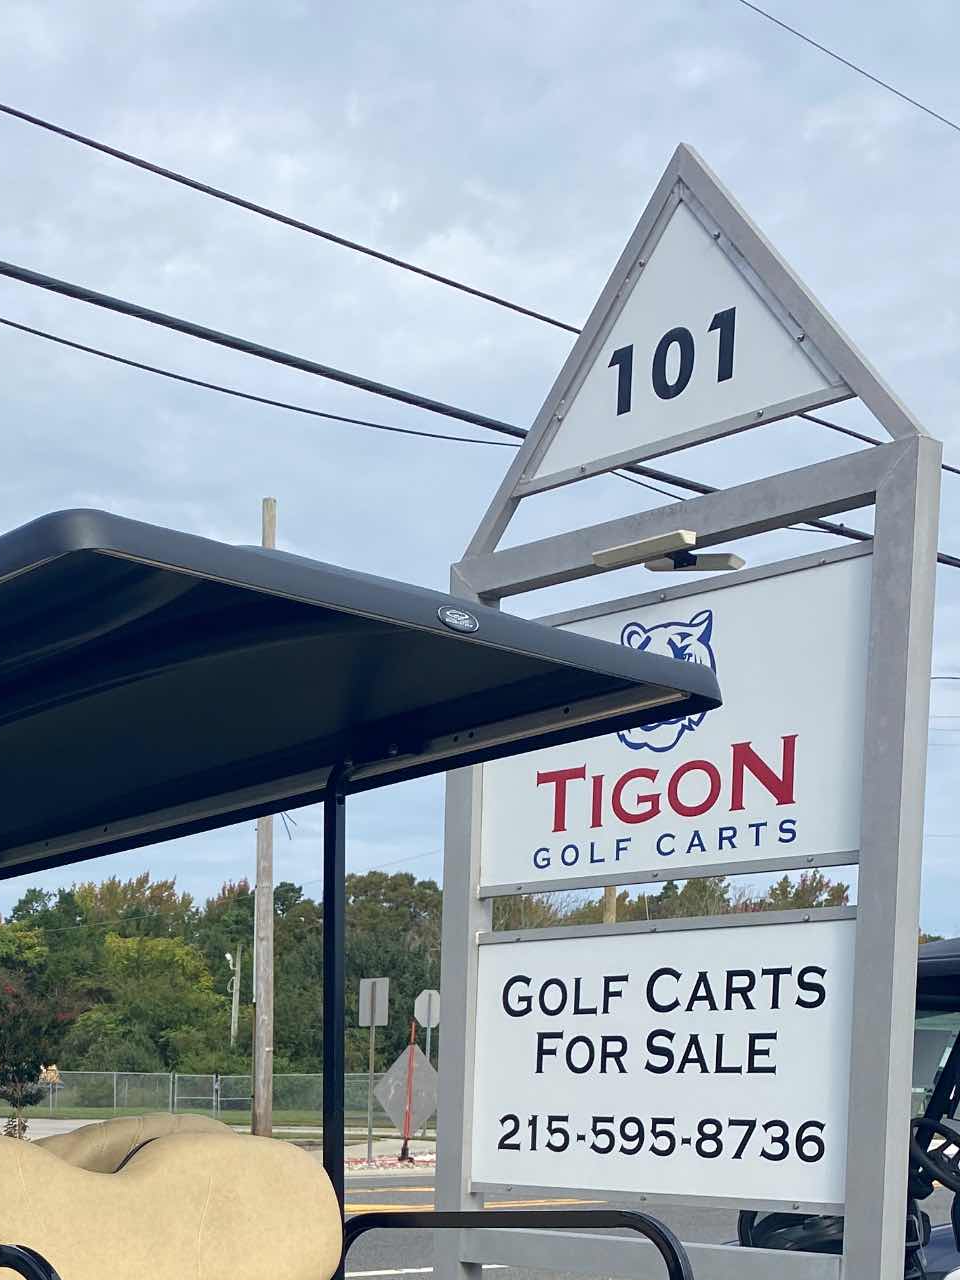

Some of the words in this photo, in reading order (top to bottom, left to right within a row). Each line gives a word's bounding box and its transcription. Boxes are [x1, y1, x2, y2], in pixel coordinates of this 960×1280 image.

[607, 306, 737, 416] 101
[536, 734, 799, 833] TIGON
[533, 836, 633, 870] GOLF
[656, 819, 799, 857] CARTS
[501, 973, 630, 1018] GOLF
[645, 965, 828, 1014] CARTS
[534, 1030, 629, 1075] FOR
[644, 1028, 779, 1076] SALE
[496, 1113, 827, 1163] 215-595-8736
